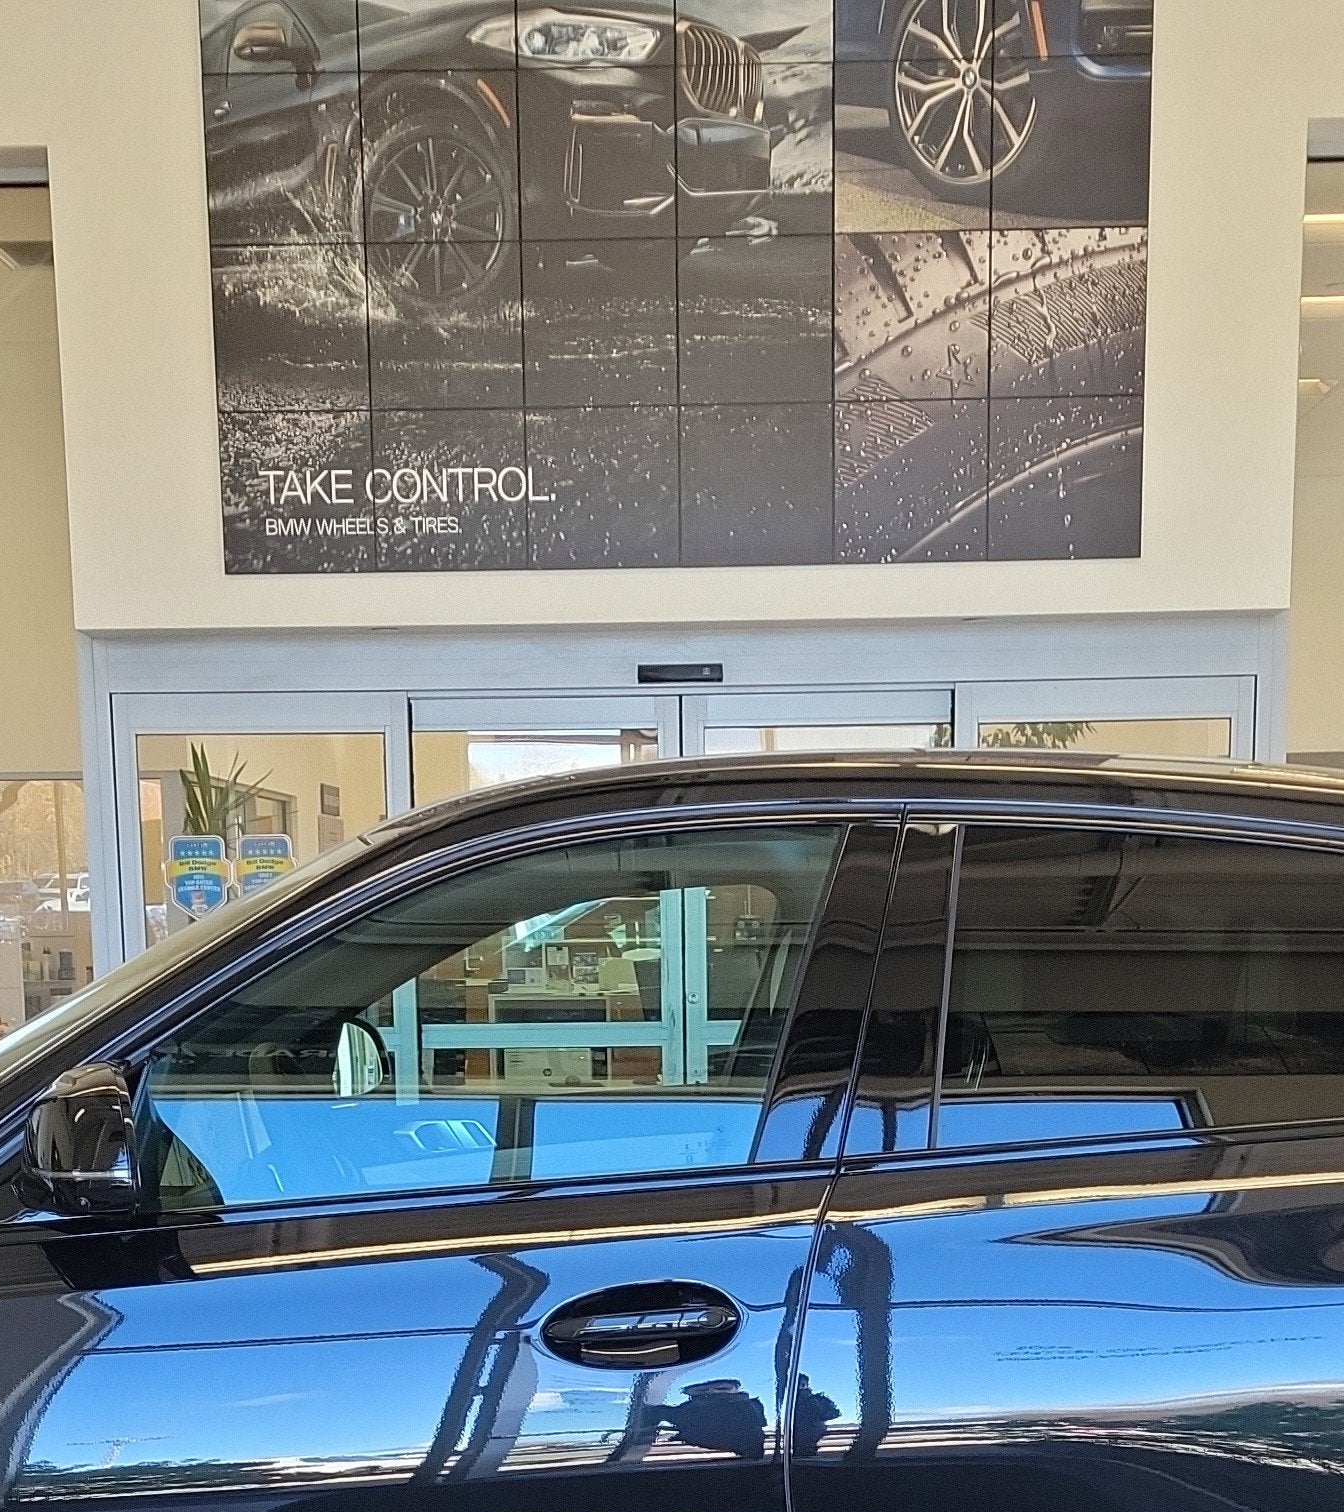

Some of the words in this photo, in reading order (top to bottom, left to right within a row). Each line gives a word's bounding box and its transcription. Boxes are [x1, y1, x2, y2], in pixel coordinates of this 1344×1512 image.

[258, 468, 354, 504] TAKE
[365, 466, 556, 503] CONTROL.
[265, 518, 312, 536] BMW
[315, 517, 389, 535] WHEELS
[394, 517, 407, 534] &
[411, 516, 463, 534] TIRES.
